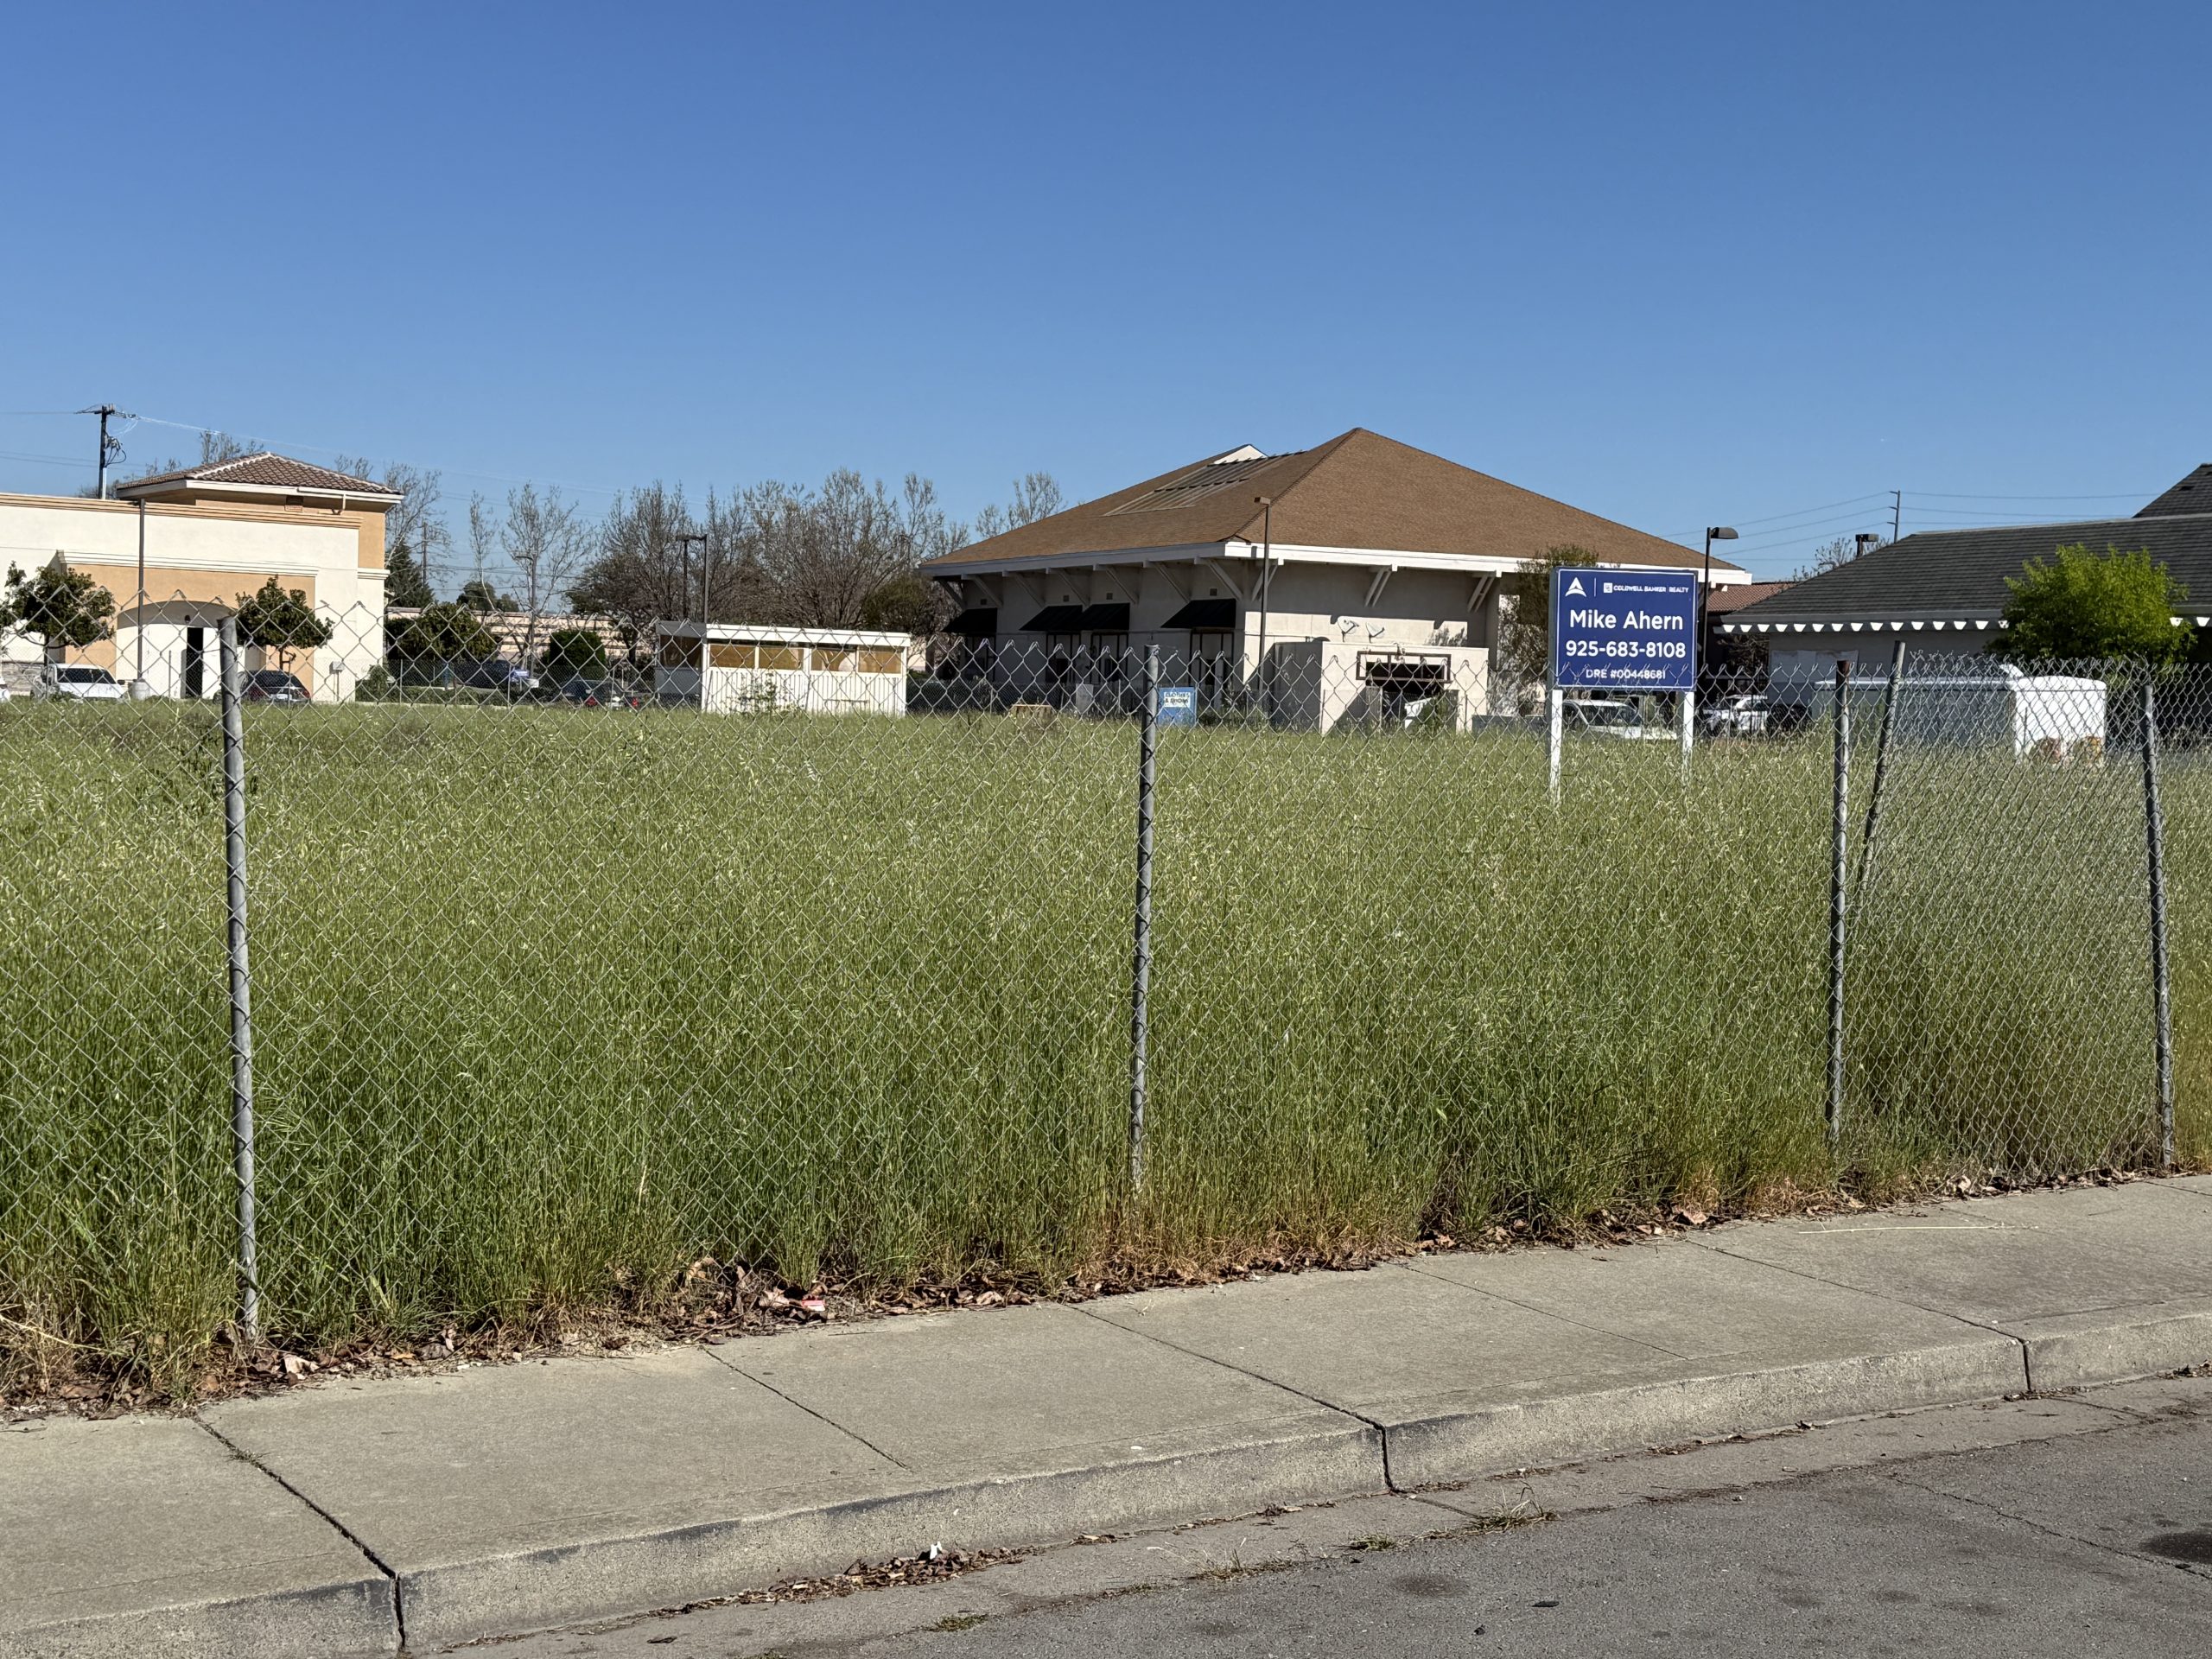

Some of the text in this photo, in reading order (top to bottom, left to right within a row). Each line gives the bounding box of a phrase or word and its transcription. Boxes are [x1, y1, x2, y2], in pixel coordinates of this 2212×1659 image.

[1569, 609, 1683, 630] Mike Ahern
[1566, 640, 1686, 658] 925-683-8108
[1586, 669, 1607, 678] DRE
